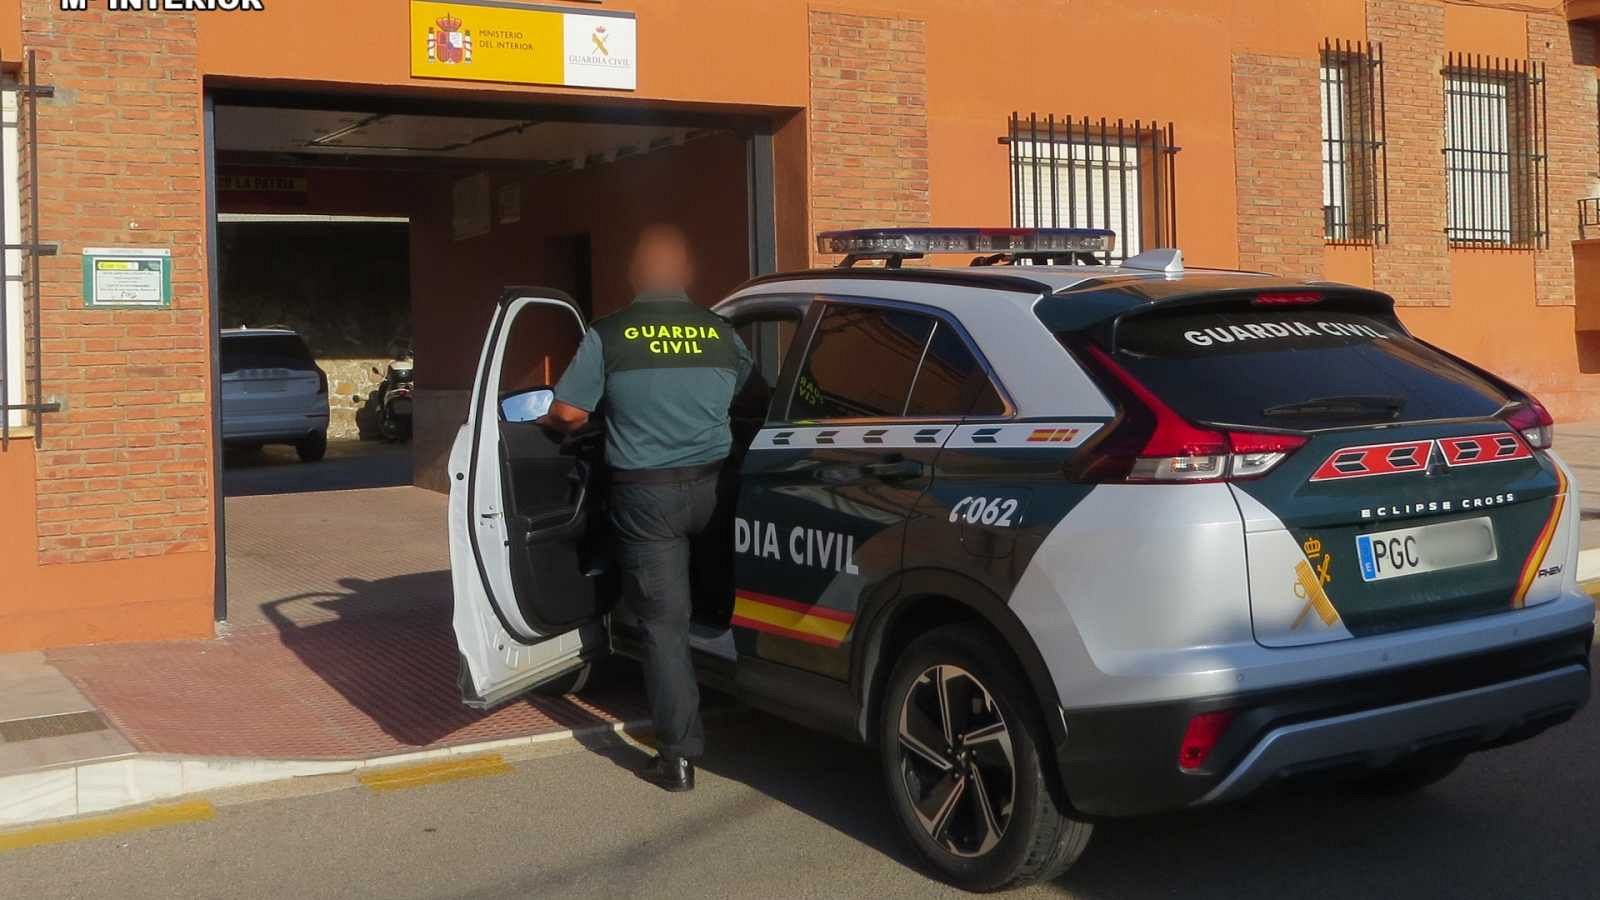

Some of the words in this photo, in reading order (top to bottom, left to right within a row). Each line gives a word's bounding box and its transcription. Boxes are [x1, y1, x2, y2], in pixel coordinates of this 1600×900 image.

[479, 30, 524, 40] MINISTERIO
[479, 40, 494, 49] DEL
[496, 41, 534, 51] INTERIOR
[568, 55, 607, 65] GUARDIA
[608, 56, 632, 66] CIVIL
[624, 325, 720, 340] GUARDIA
[1183, 320, 1322, 346] GUARDIA
[1316, 321, 1390, 340] CIVIL
[649, 340, 703, 354] CIVIL
[1361, 501, 1451, 519] ECLIPSE
[1462, 493, 1515, 508] CROSS
[789, 526, 859, 576] CIVIL
[1373, 535, 1420, 573] PGC
[1537, 563, 1564, 580] PHEV
